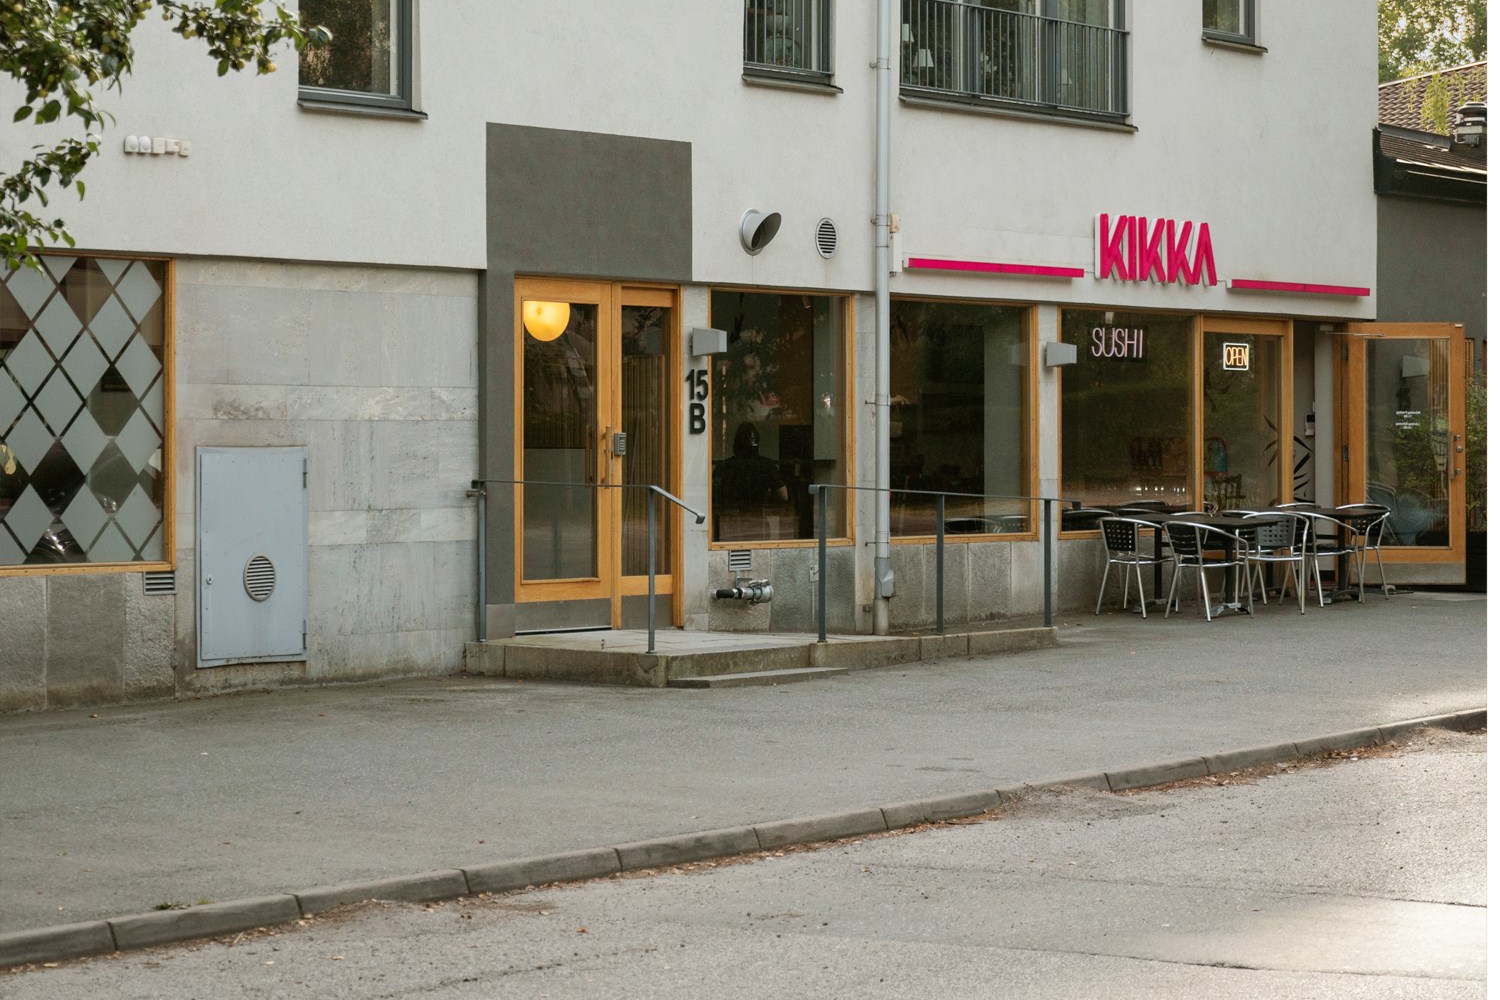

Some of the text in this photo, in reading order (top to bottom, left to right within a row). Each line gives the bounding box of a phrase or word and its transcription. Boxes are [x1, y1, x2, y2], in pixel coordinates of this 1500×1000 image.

[1097, 213, 1218, 287] KIKKA
[1091, 327, 1144, 359] SUSHI
[1225, 346, 1248, 366] OPEN
[685, 369, 708, 401] 15
[689, 403, 706, 435] B
